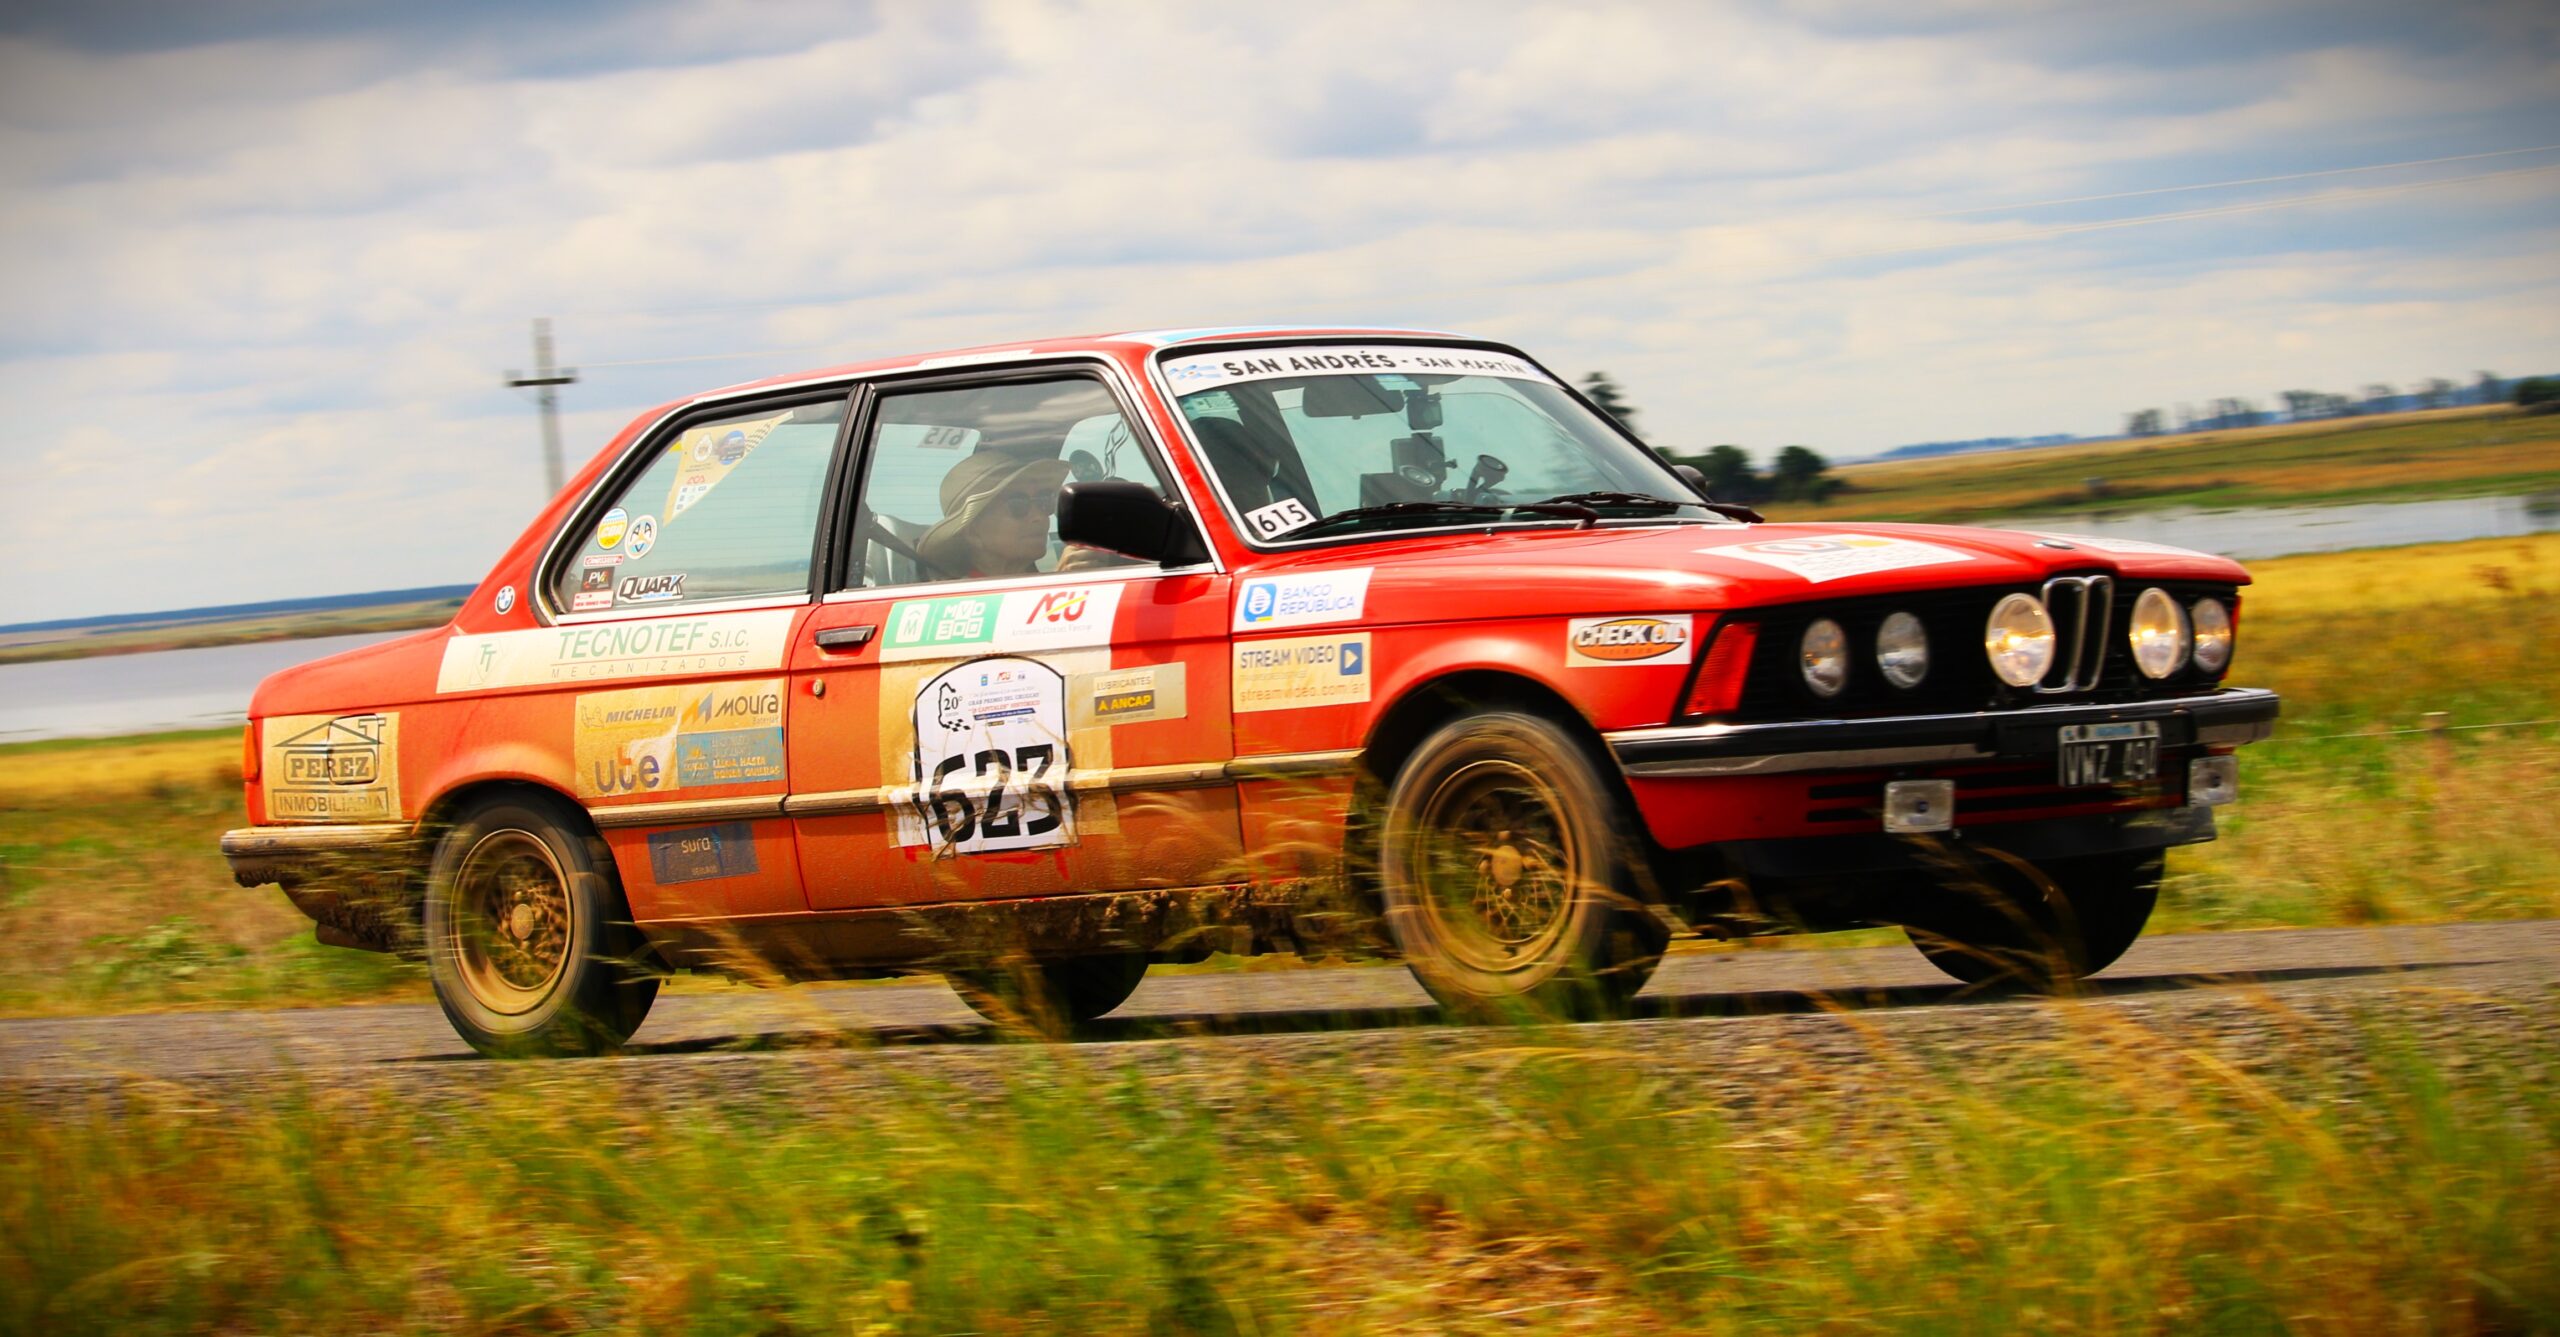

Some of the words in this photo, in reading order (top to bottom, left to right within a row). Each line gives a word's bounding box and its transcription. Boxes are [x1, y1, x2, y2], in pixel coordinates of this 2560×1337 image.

[1223, 358, 1283, 376] SAN
[1289, 350, 1397, 371] ANDRÉS
[1415, 357, 1456, 368] SAN
[1458, 359, 1527, 374] MARTÍN
[1258, 503, 1307, 533] 615
[620, 574, 687, 600] QUARK
[1282, 584, 1332, 600] BANCO
[1026, 590, 1090, 625] ACU
[558, 622, 708, 660] TECNOTEF
[709, 629, 750, 649] S.I.C.
[1577, 624, 1647, 646] CHECK
[1651, 623, 1687, 644] OIL
[551, 655, 746, 678] MECANIZADOS
[1240, 648, 1292, 669] STREAM
[1294, 645, 1336, 665] VIDEO
[1096, 676, 1152, 690] LUBRICANTES
[1110, 694, 1152, 710] ANCAP
[605, 706, 677, 723] MICHELIN
[290, 757, 369, 778] PEREZ
[595, 743, 660, 792] ute
[2065, 744, 2111, 785] VWZ
[280, 796, 385, 812] INMOBILIARIA
[929, 743, 1062, 843] 623
[681, 837, 711, 854] sura
